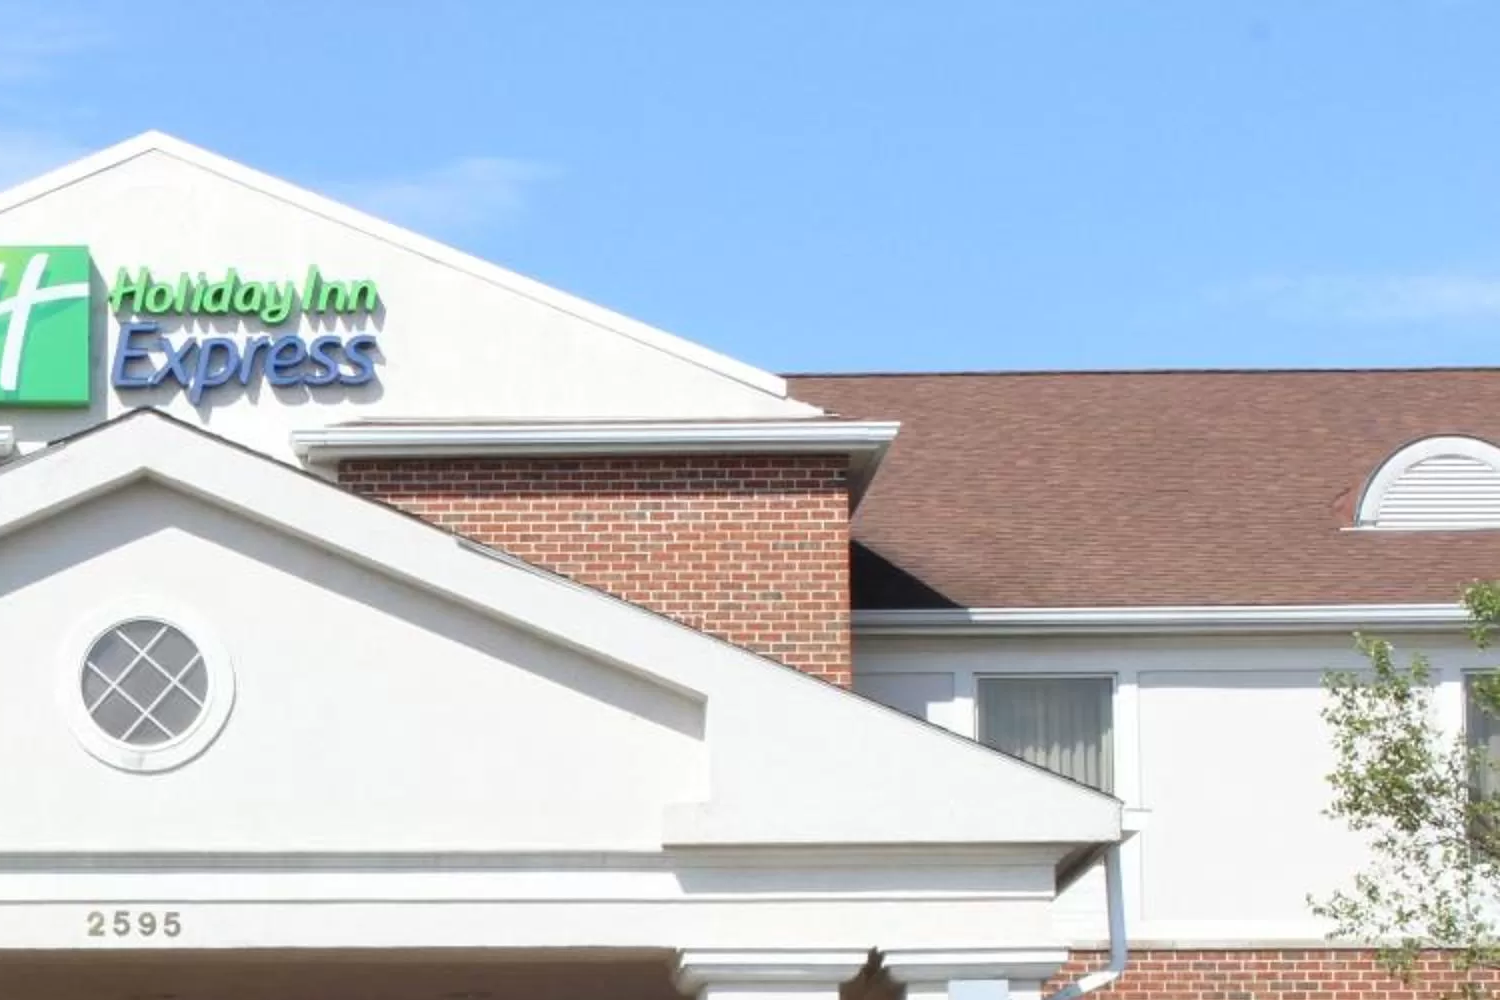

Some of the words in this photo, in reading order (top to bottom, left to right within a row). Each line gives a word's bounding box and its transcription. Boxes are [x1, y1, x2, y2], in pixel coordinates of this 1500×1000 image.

[110, 266, 294, 324] Holiday
[302, 264, 378, 316] Inn
[111, 320, 378, 402] Express
[86, 910, 182, 937] 2595
